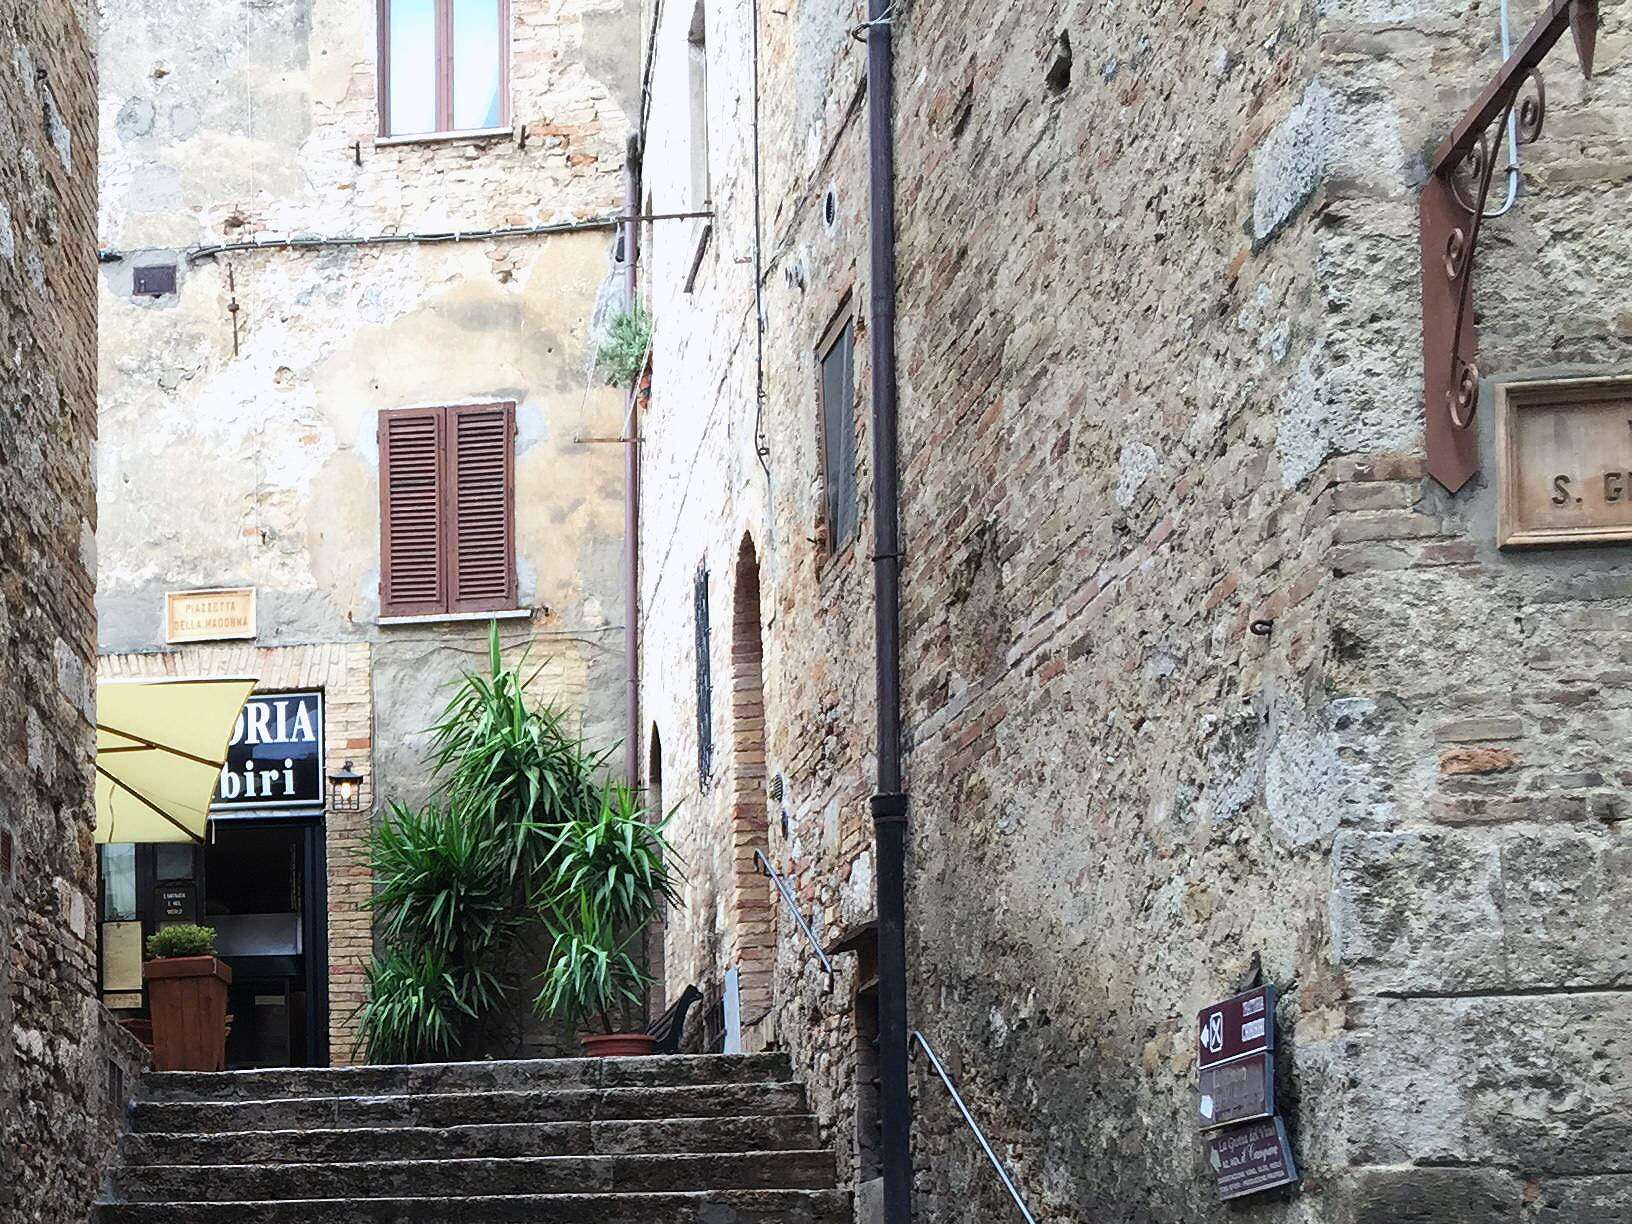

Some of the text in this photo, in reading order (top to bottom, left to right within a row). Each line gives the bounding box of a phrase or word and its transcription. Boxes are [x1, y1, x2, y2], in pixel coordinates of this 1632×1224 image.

[1551, 472, 1632, 505] S. G
[185, 601, 236, 613] PIAZZETTA
[212, 758, 296, 799] biri
